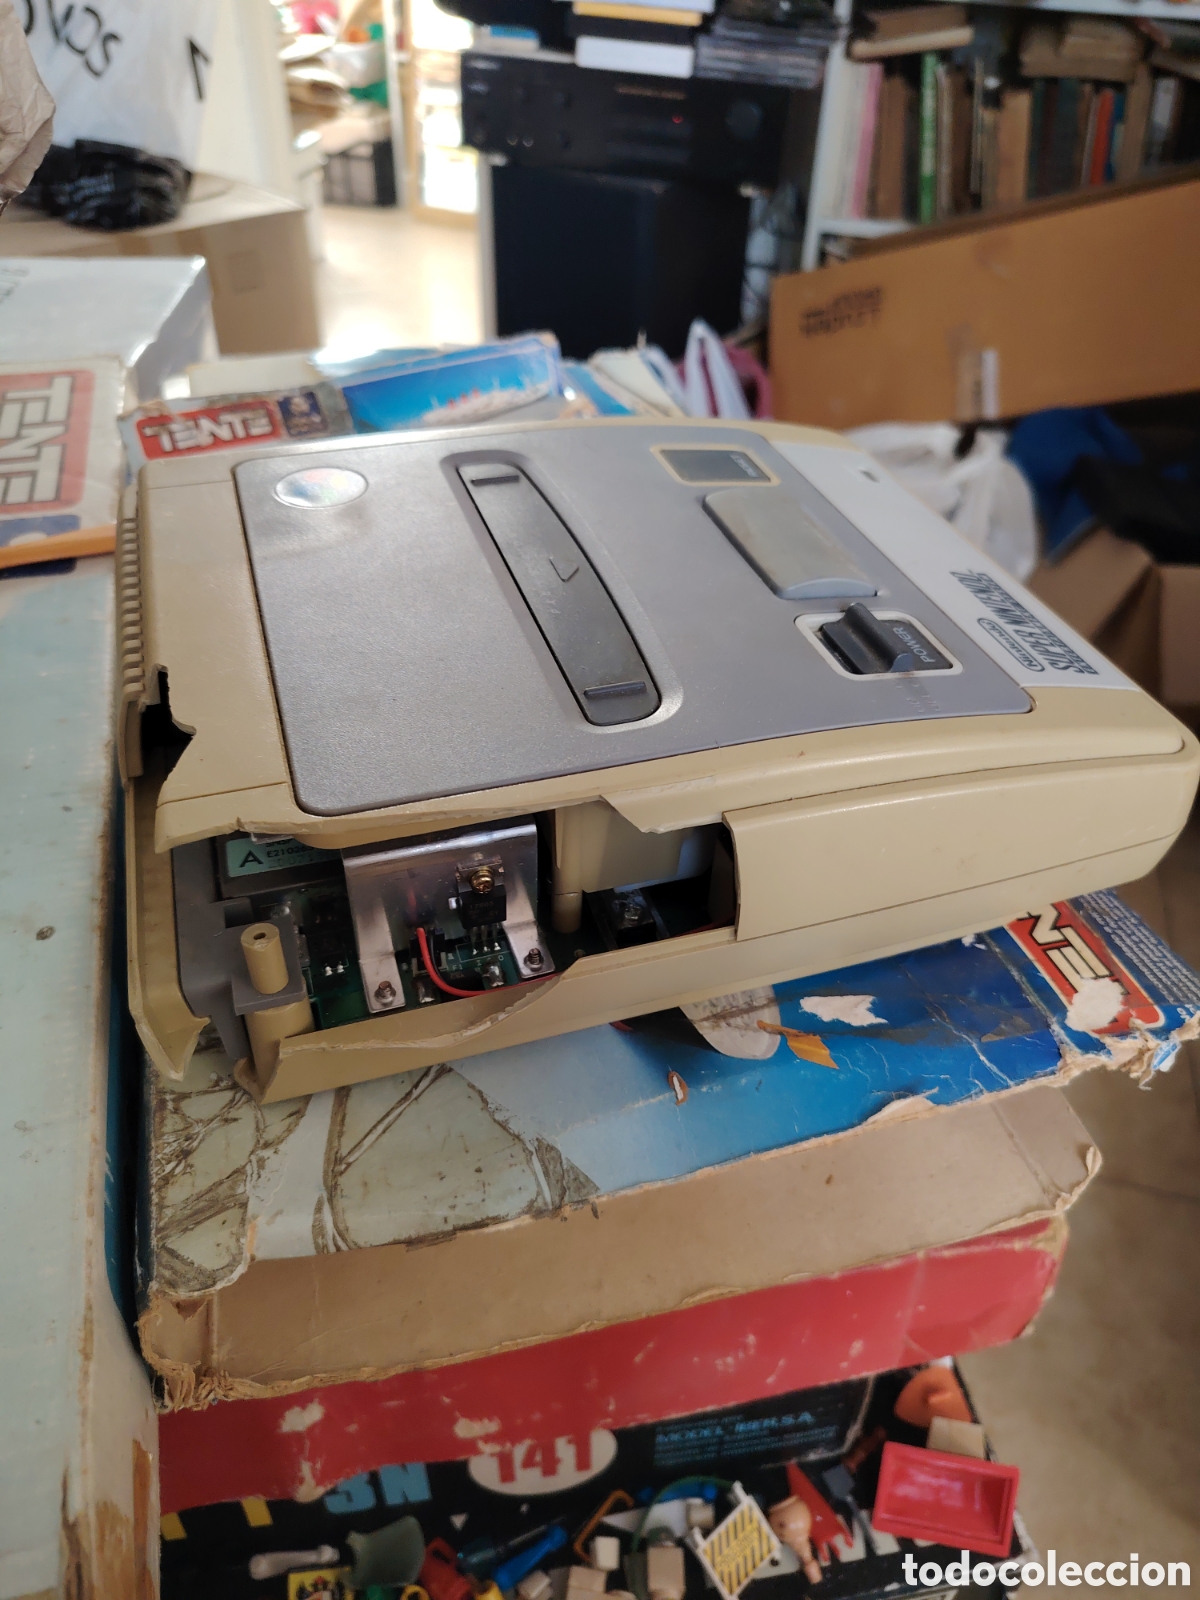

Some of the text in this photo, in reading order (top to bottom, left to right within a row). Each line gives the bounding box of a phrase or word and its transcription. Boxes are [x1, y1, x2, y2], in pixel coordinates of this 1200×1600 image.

[142, 408, 274, 453] TENTE
[892, 626, 936, 664] POWER
[1012, 629, 1086, 675] SUPER
[239, 849, 264, 868] A
